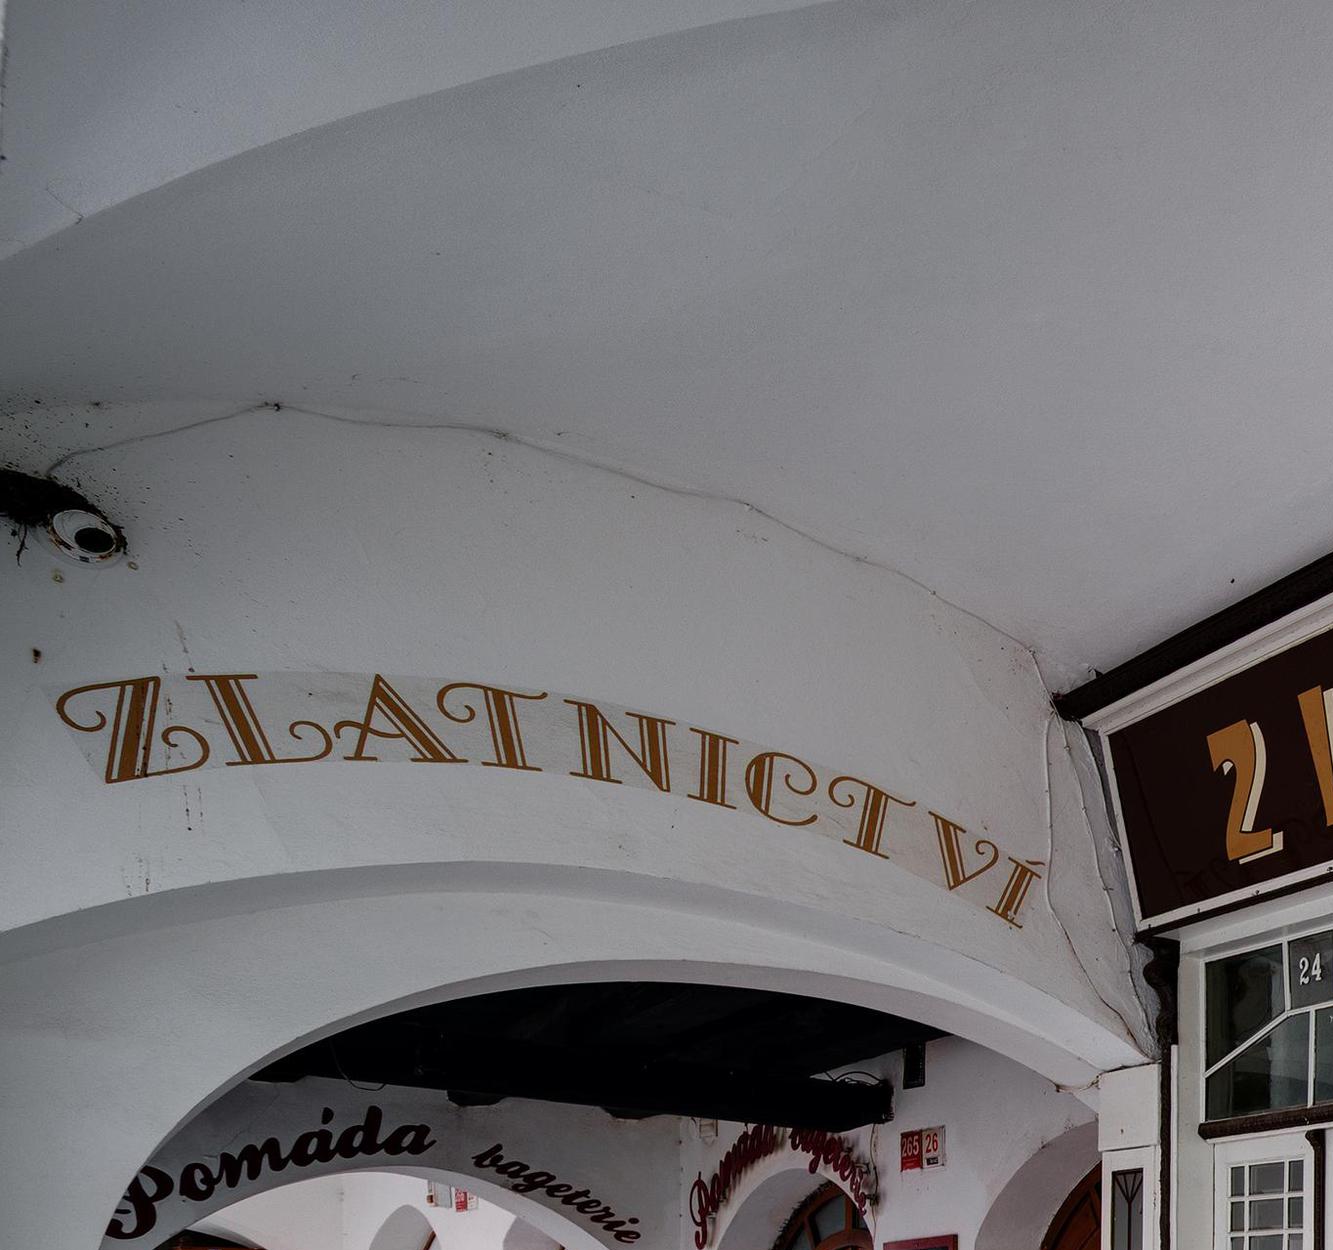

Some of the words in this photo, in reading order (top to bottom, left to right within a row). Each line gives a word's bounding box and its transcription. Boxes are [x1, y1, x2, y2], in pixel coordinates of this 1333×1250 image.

[56, 673, 1043, 928] ZLATNICTVÍ
[1299, 952, 1322, 986] 24
[105, 1105, 437, 1240] Pomáda
[471, 1143, 642, 1244] bageterie
[902, 1135, 920, 1157] 265
[925, 1132, 939, 1154] 26
